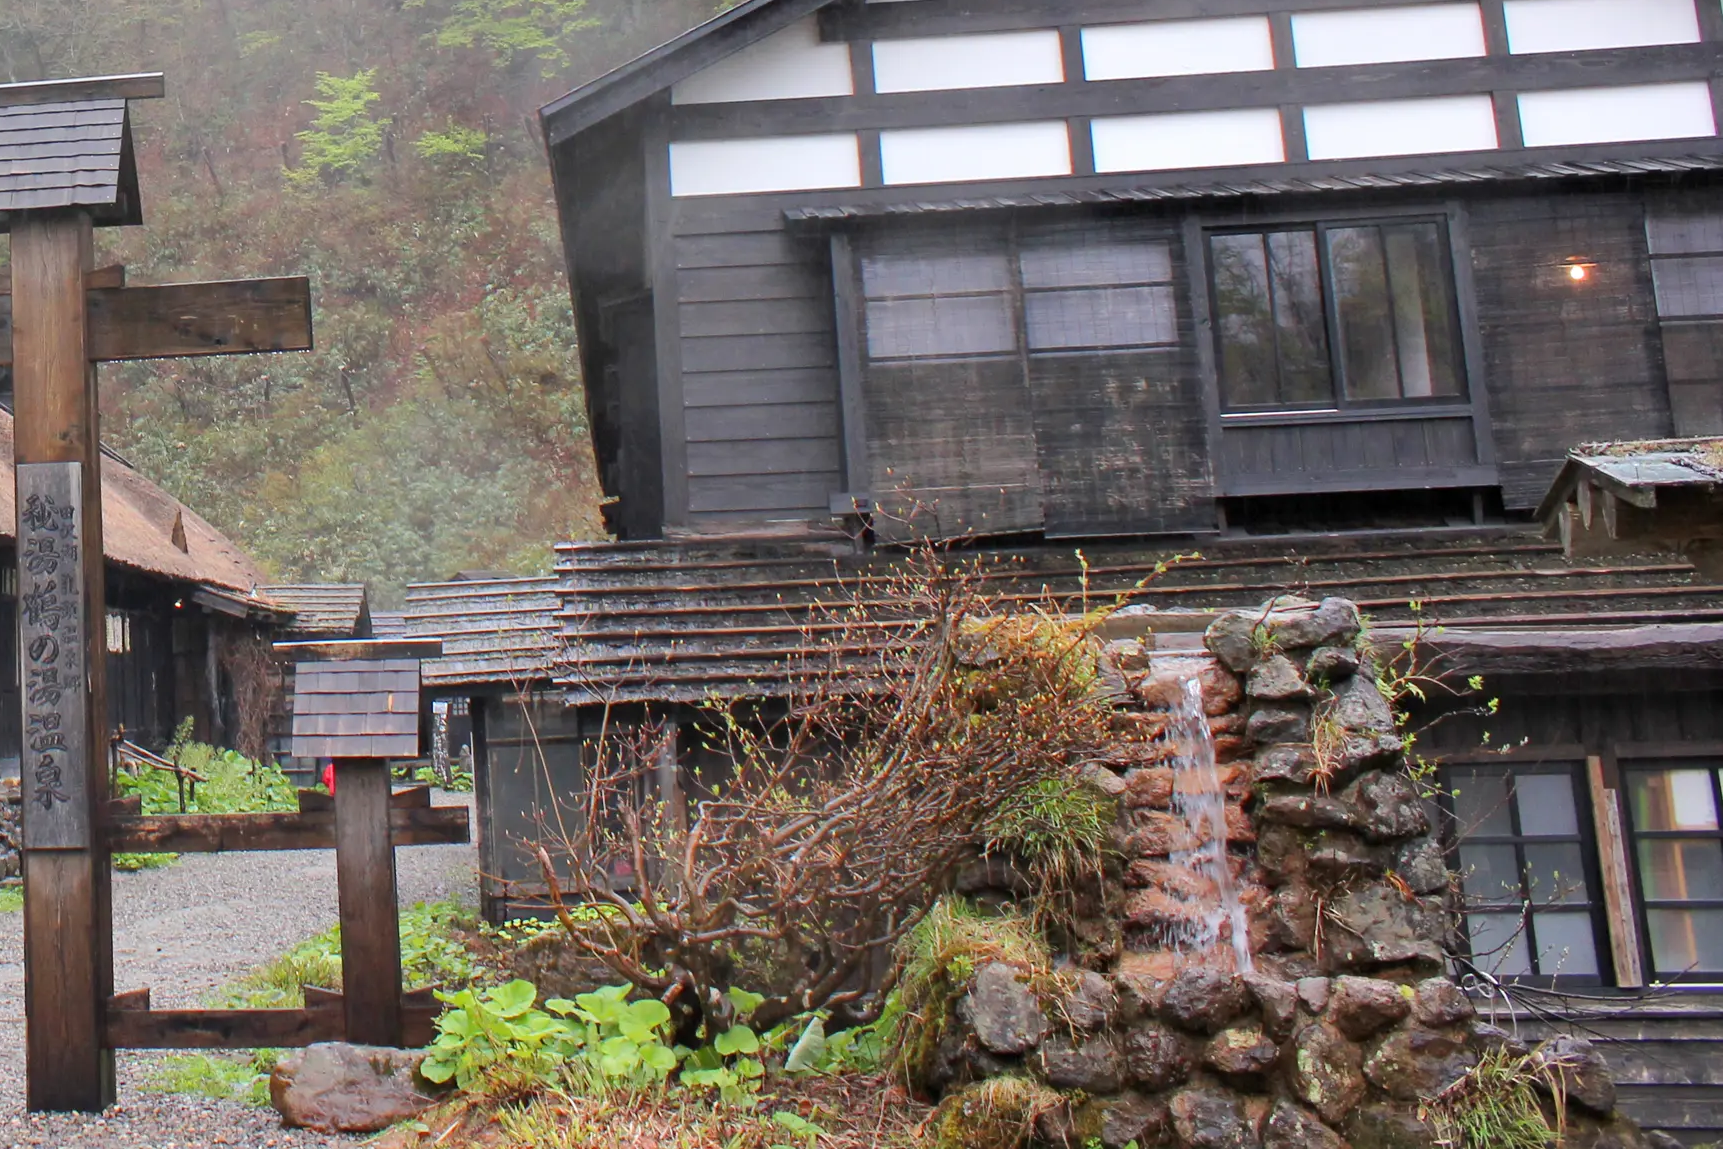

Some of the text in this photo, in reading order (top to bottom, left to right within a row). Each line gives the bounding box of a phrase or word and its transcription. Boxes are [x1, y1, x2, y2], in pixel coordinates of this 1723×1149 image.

[22, 495, 69, 809] 秘湯鶴の湯温泉
